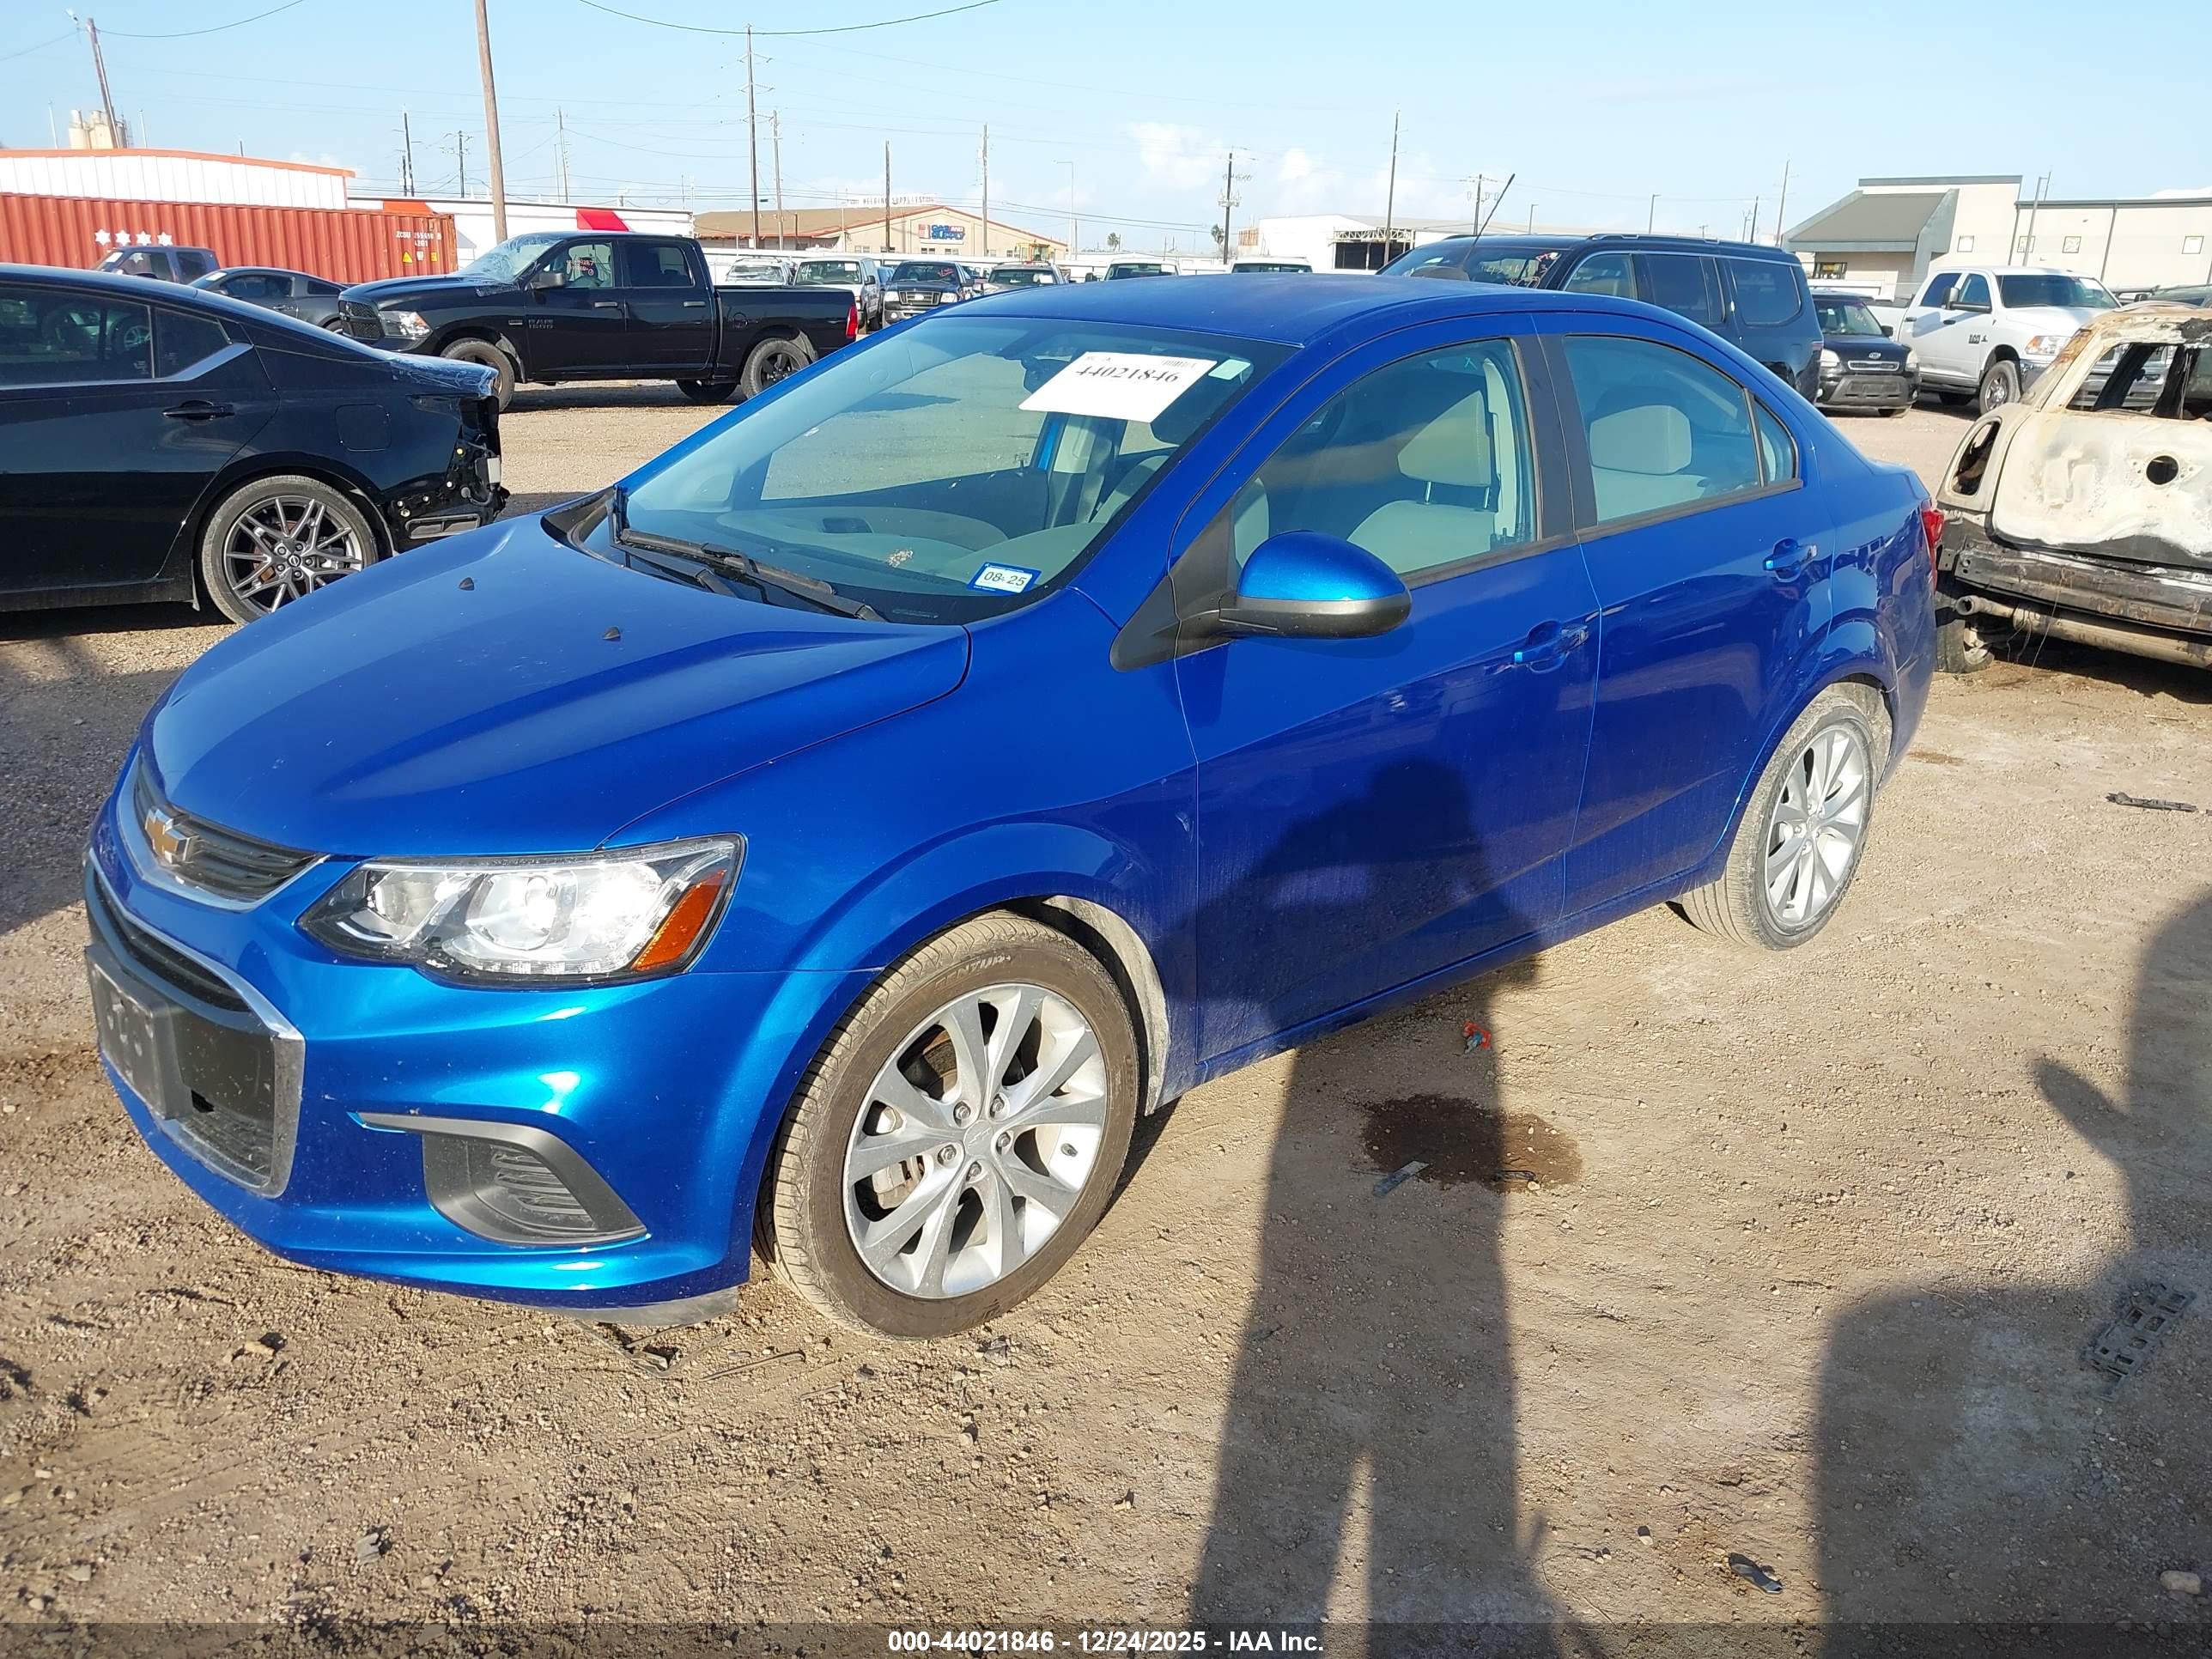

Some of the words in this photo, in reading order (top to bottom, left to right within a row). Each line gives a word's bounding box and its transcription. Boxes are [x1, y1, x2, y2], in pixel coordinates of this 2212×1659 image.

[1075, 365, 1182, 383] 44021846
[983, 571, 1003, 582] 08
[1006, 574, 1028, 586] 25
